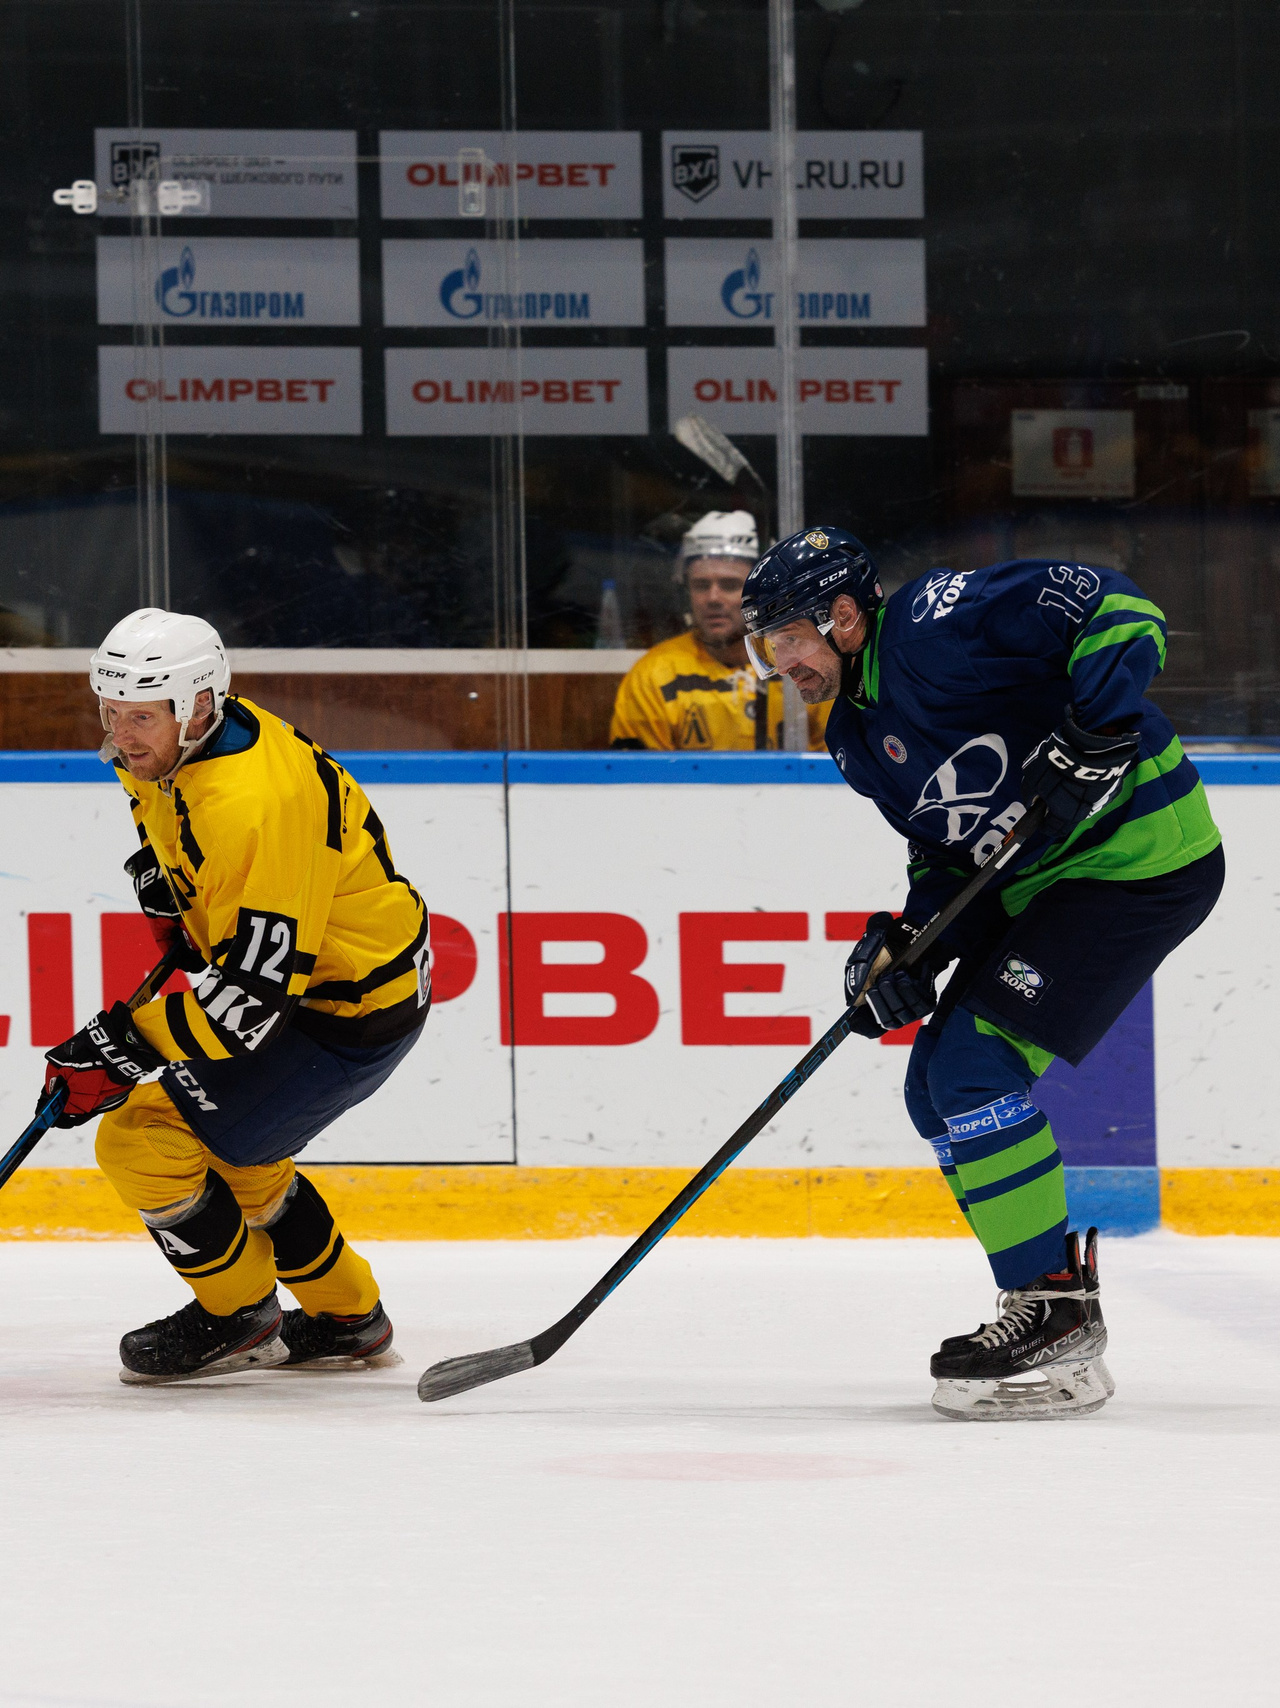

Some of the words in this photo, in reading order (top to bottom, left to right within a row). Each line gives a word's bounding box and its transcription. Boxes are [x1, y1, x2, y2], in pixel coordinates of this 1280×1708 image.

[406, 163, 616, 187] OLIMPBET
[732, 160, 905, 189] VHRU.RU
[199, 291, 305, 318] ГАЗПРОМ
[764, 292, 871, 319] ГЗПРОМ
[125, 378, 335, 403] OLIMPBET
[412, 379, 621, 404] OLIMPBET
[818, 567, 849, 588] CCM
[932, 569, 976, 620] ХОР
[1036, 566, 1101, 624] 13
[97, 667, 127, 679] CCM
[193, 669, 215, 685] CCM
[1047, 745, 1132, 781] CCM
[239, 916, 291, 984] 12
[999, 970, 1037, 1000] ХОРС
[169, 1060, 219, 1112] CCM
[951, 1115, 994, 1135] ХОРС
